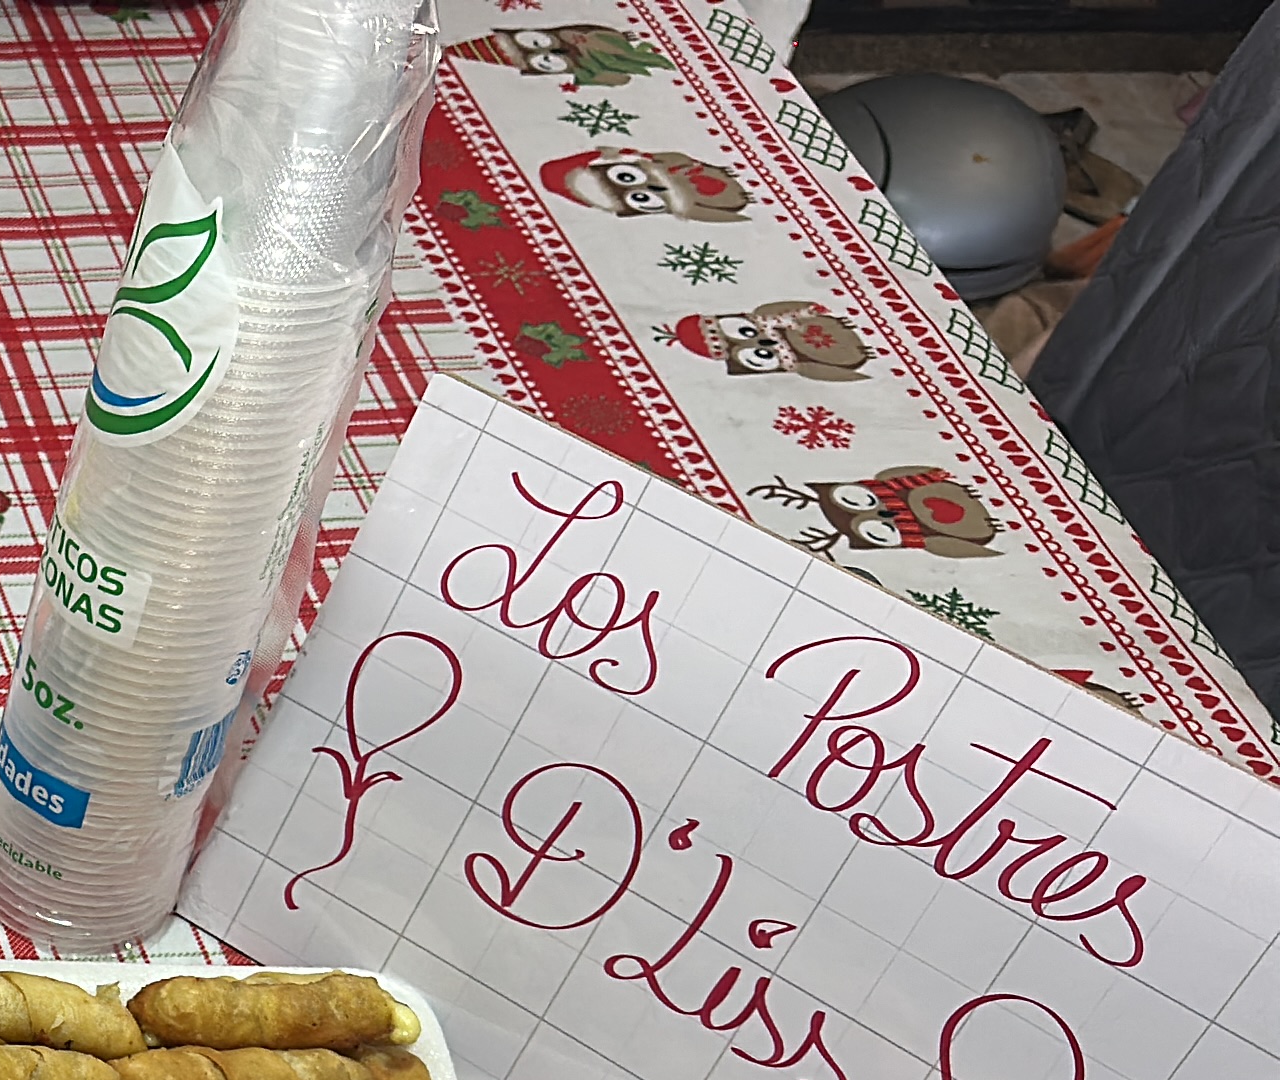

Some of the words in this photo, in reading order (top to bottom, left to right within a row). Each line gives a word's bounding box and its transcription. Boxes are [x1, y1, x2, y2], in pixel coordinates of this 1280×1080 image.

[42, 552, 124, 634] ONAS
[439, 470, 660, 696] Los
[766, 635, 1147, 969] Postres
